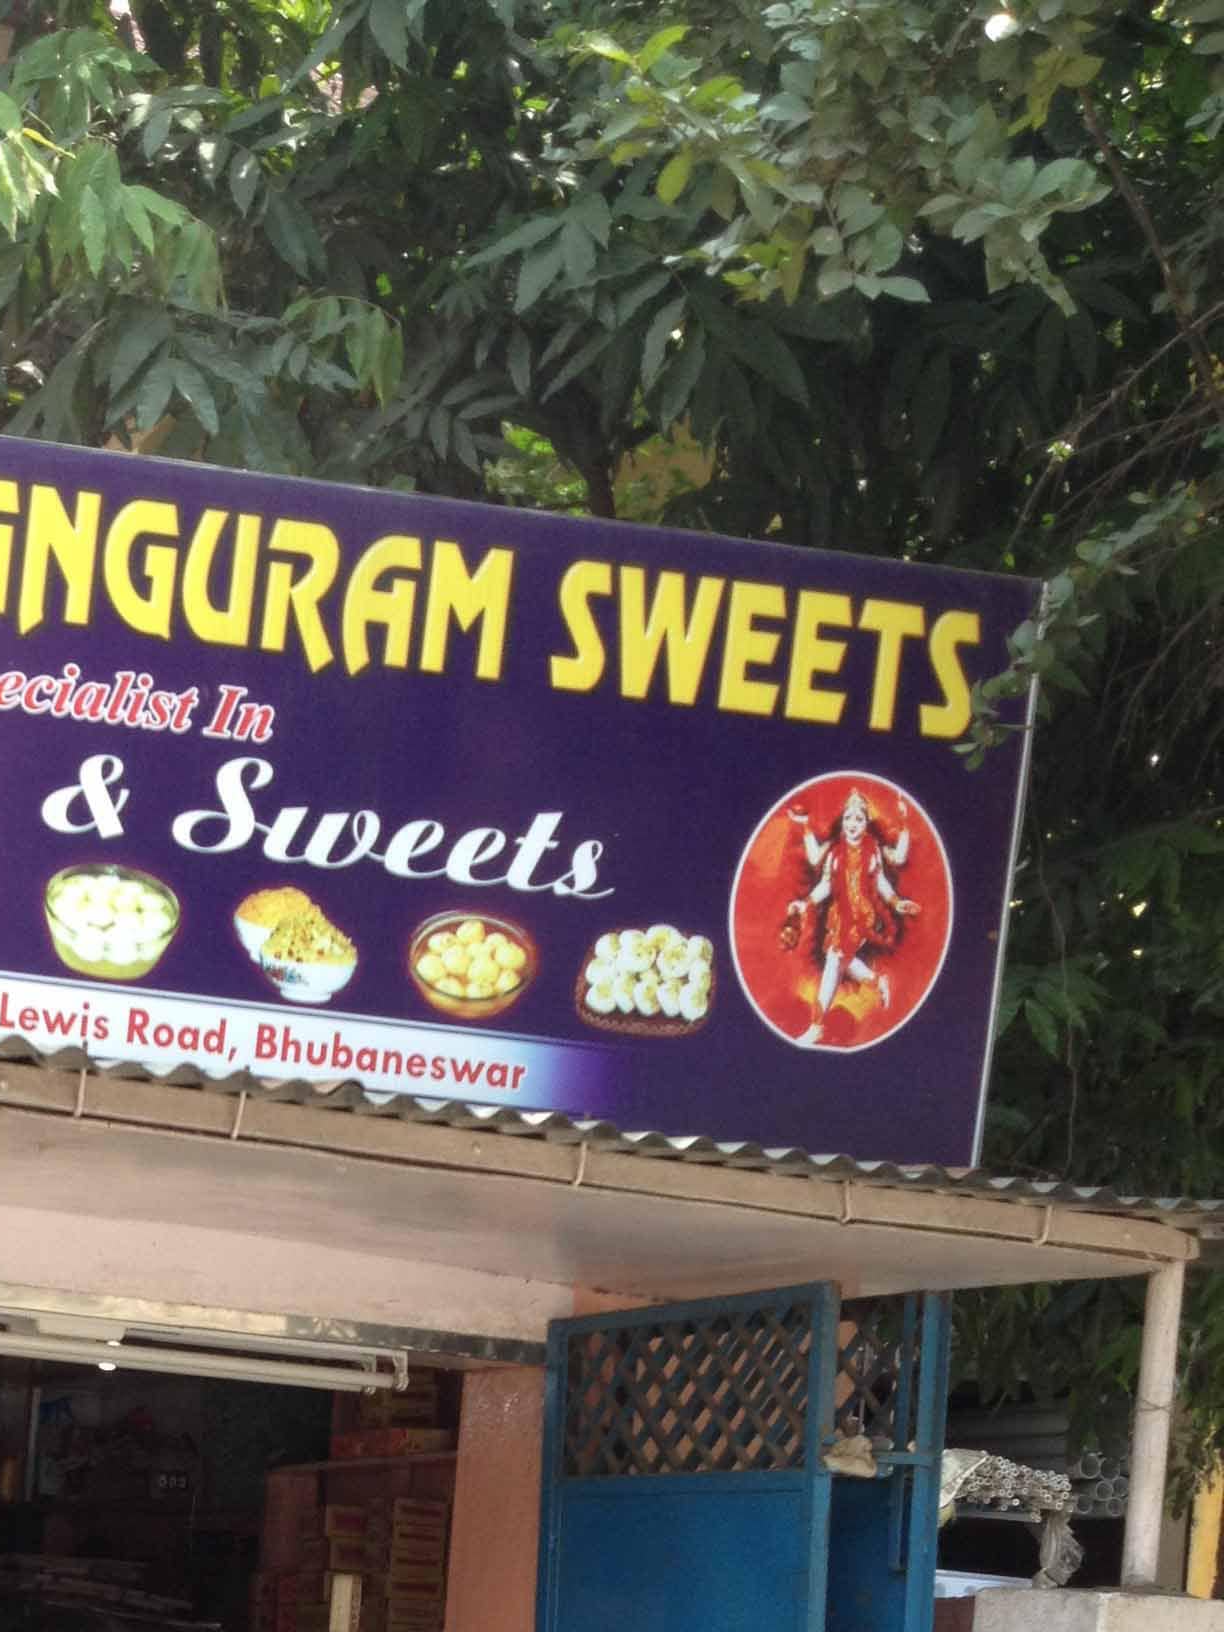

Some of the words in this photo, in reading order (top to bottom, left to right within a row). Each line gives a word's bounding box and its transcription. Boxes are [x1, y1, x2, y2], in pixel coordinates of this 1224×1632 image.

[550, 559, 981, 740] SWEETS
[203, 684, 275, 743] In
[40, 753, 131, 840] &
[171, 755, 616, 900] Sweets
[0, 990, 110, 1044] Lewis
[126, 1007, 239, 1060] Road,
[255, 1022, 526, 1091] Bhubaneswar
